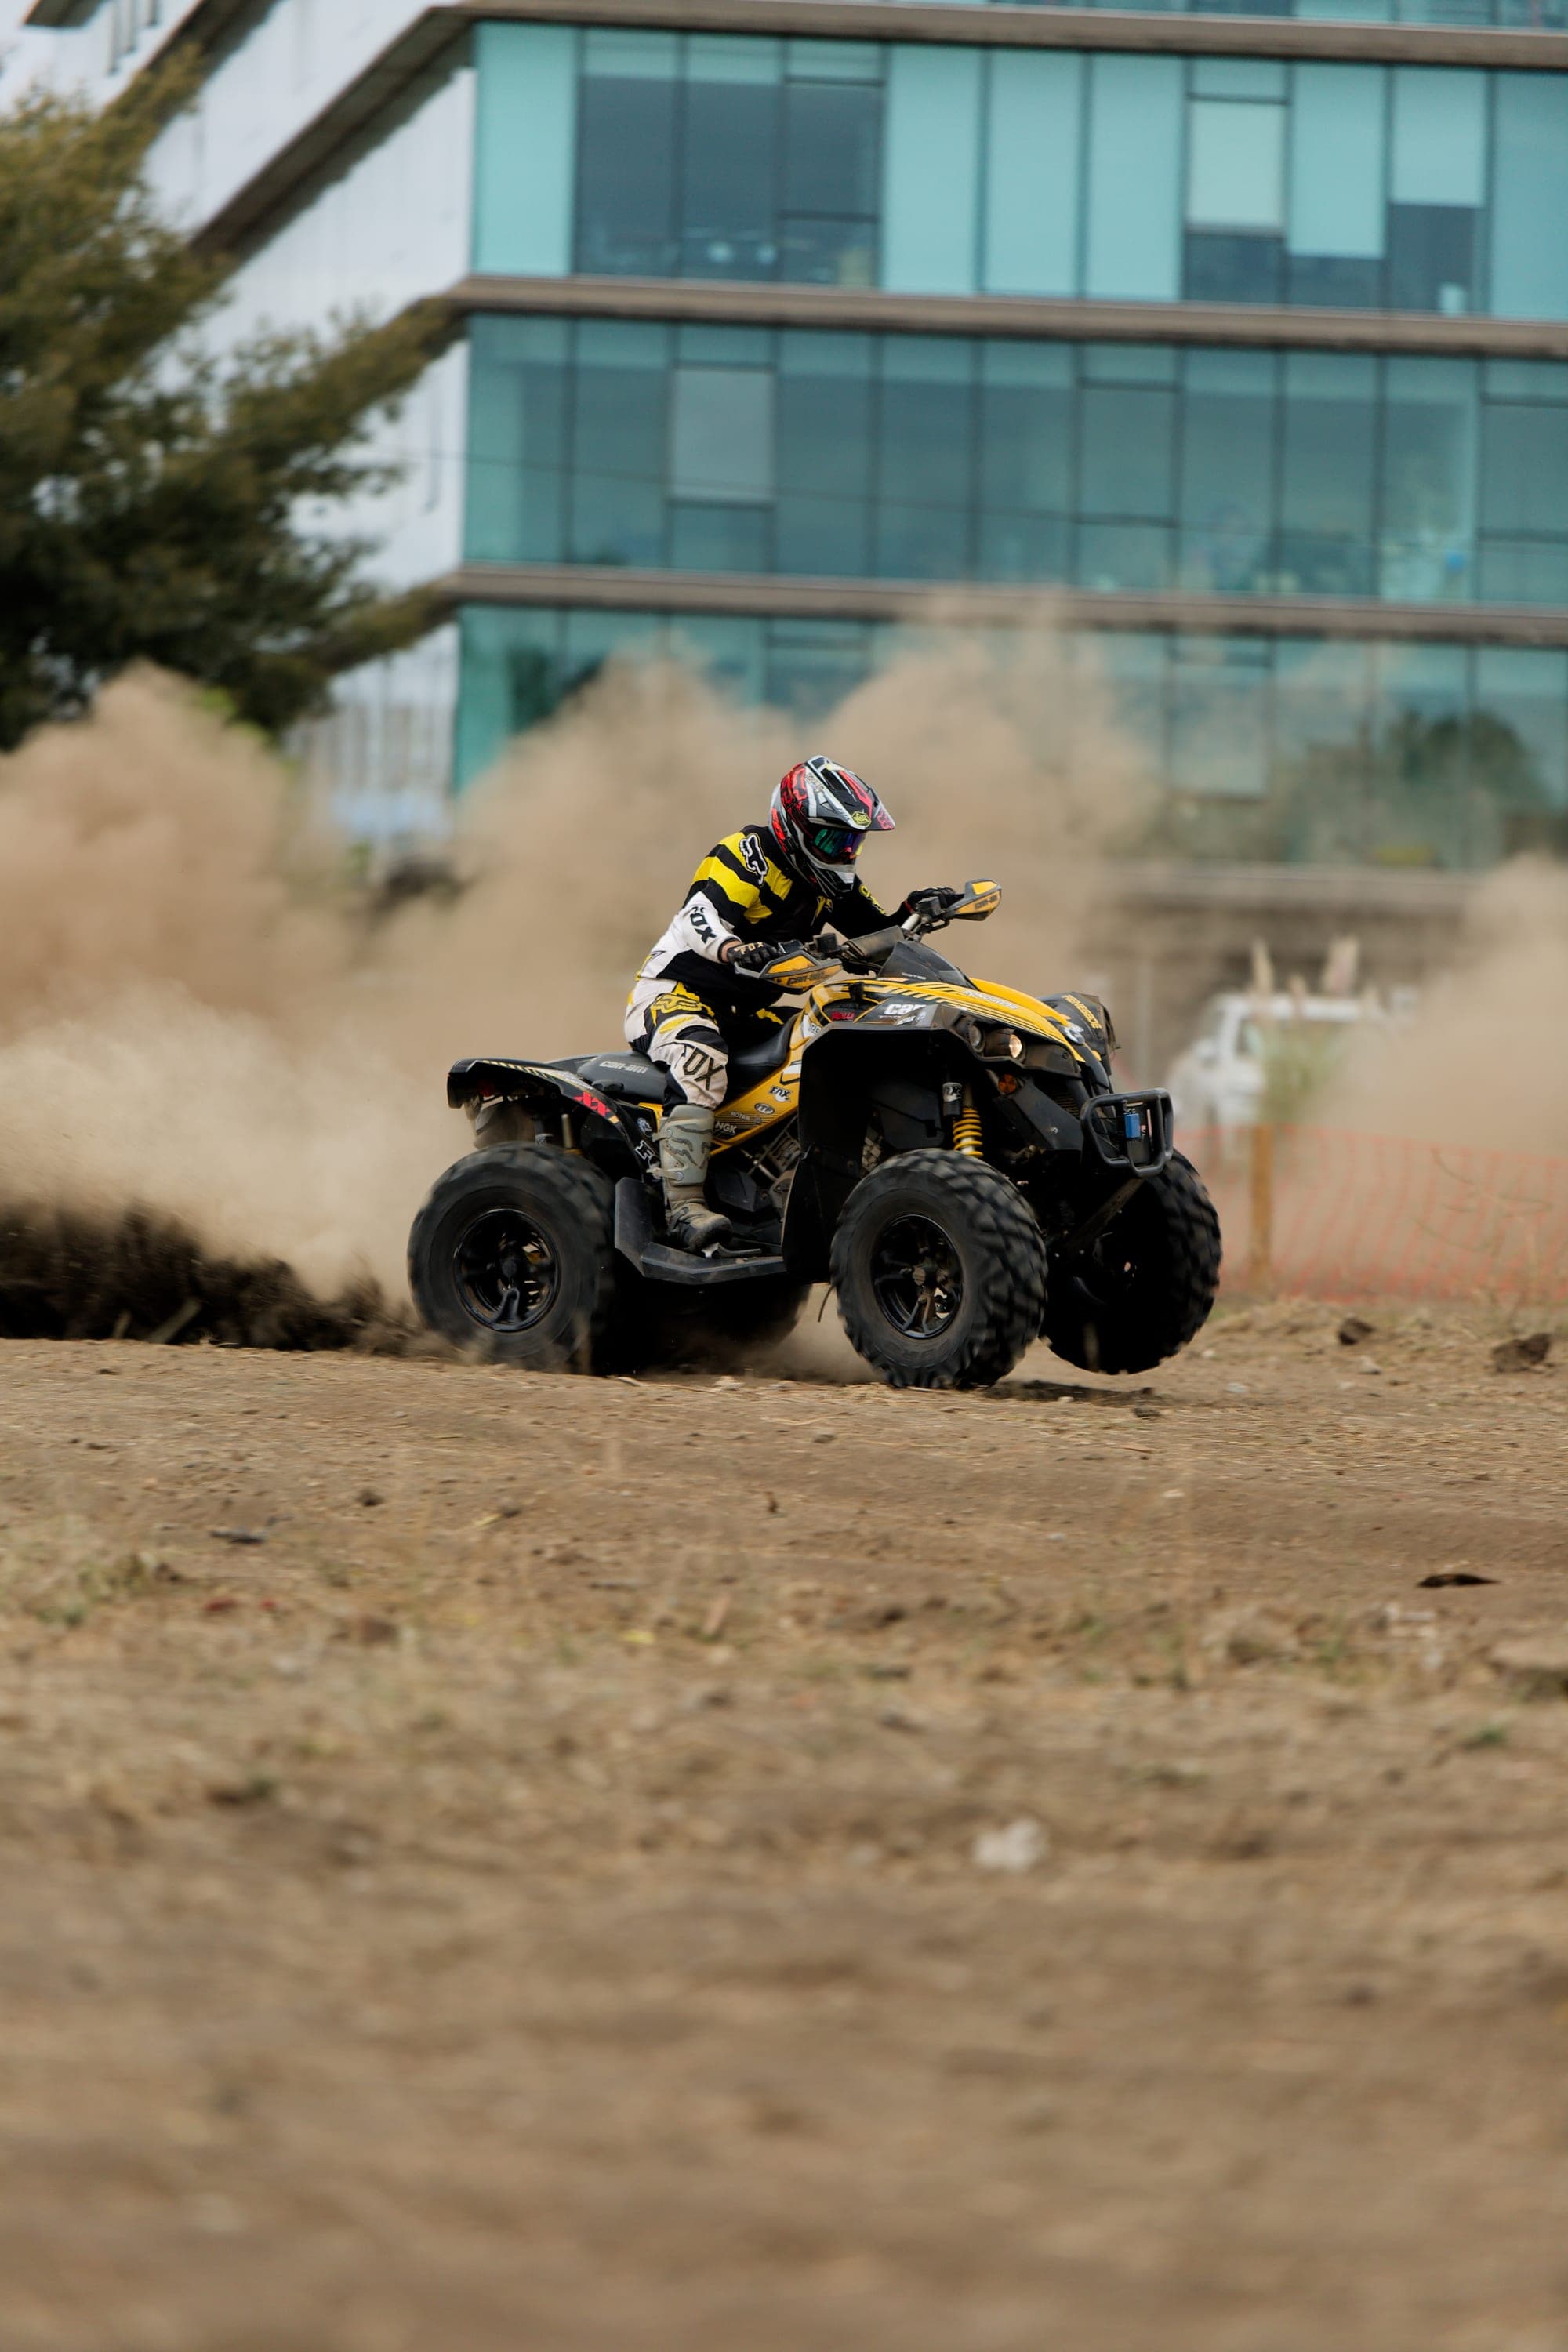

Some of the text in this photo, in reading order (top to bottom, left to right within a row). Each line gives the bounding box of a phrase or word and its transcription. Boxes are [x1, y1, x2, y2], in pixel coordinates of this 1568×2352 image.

[734, 941, 764, 955] FOX
[679, 1047, 725, 1091] OX
[769, 1087, 791, 1100] FOX
[714, 1121, 738, 1134] NGK
